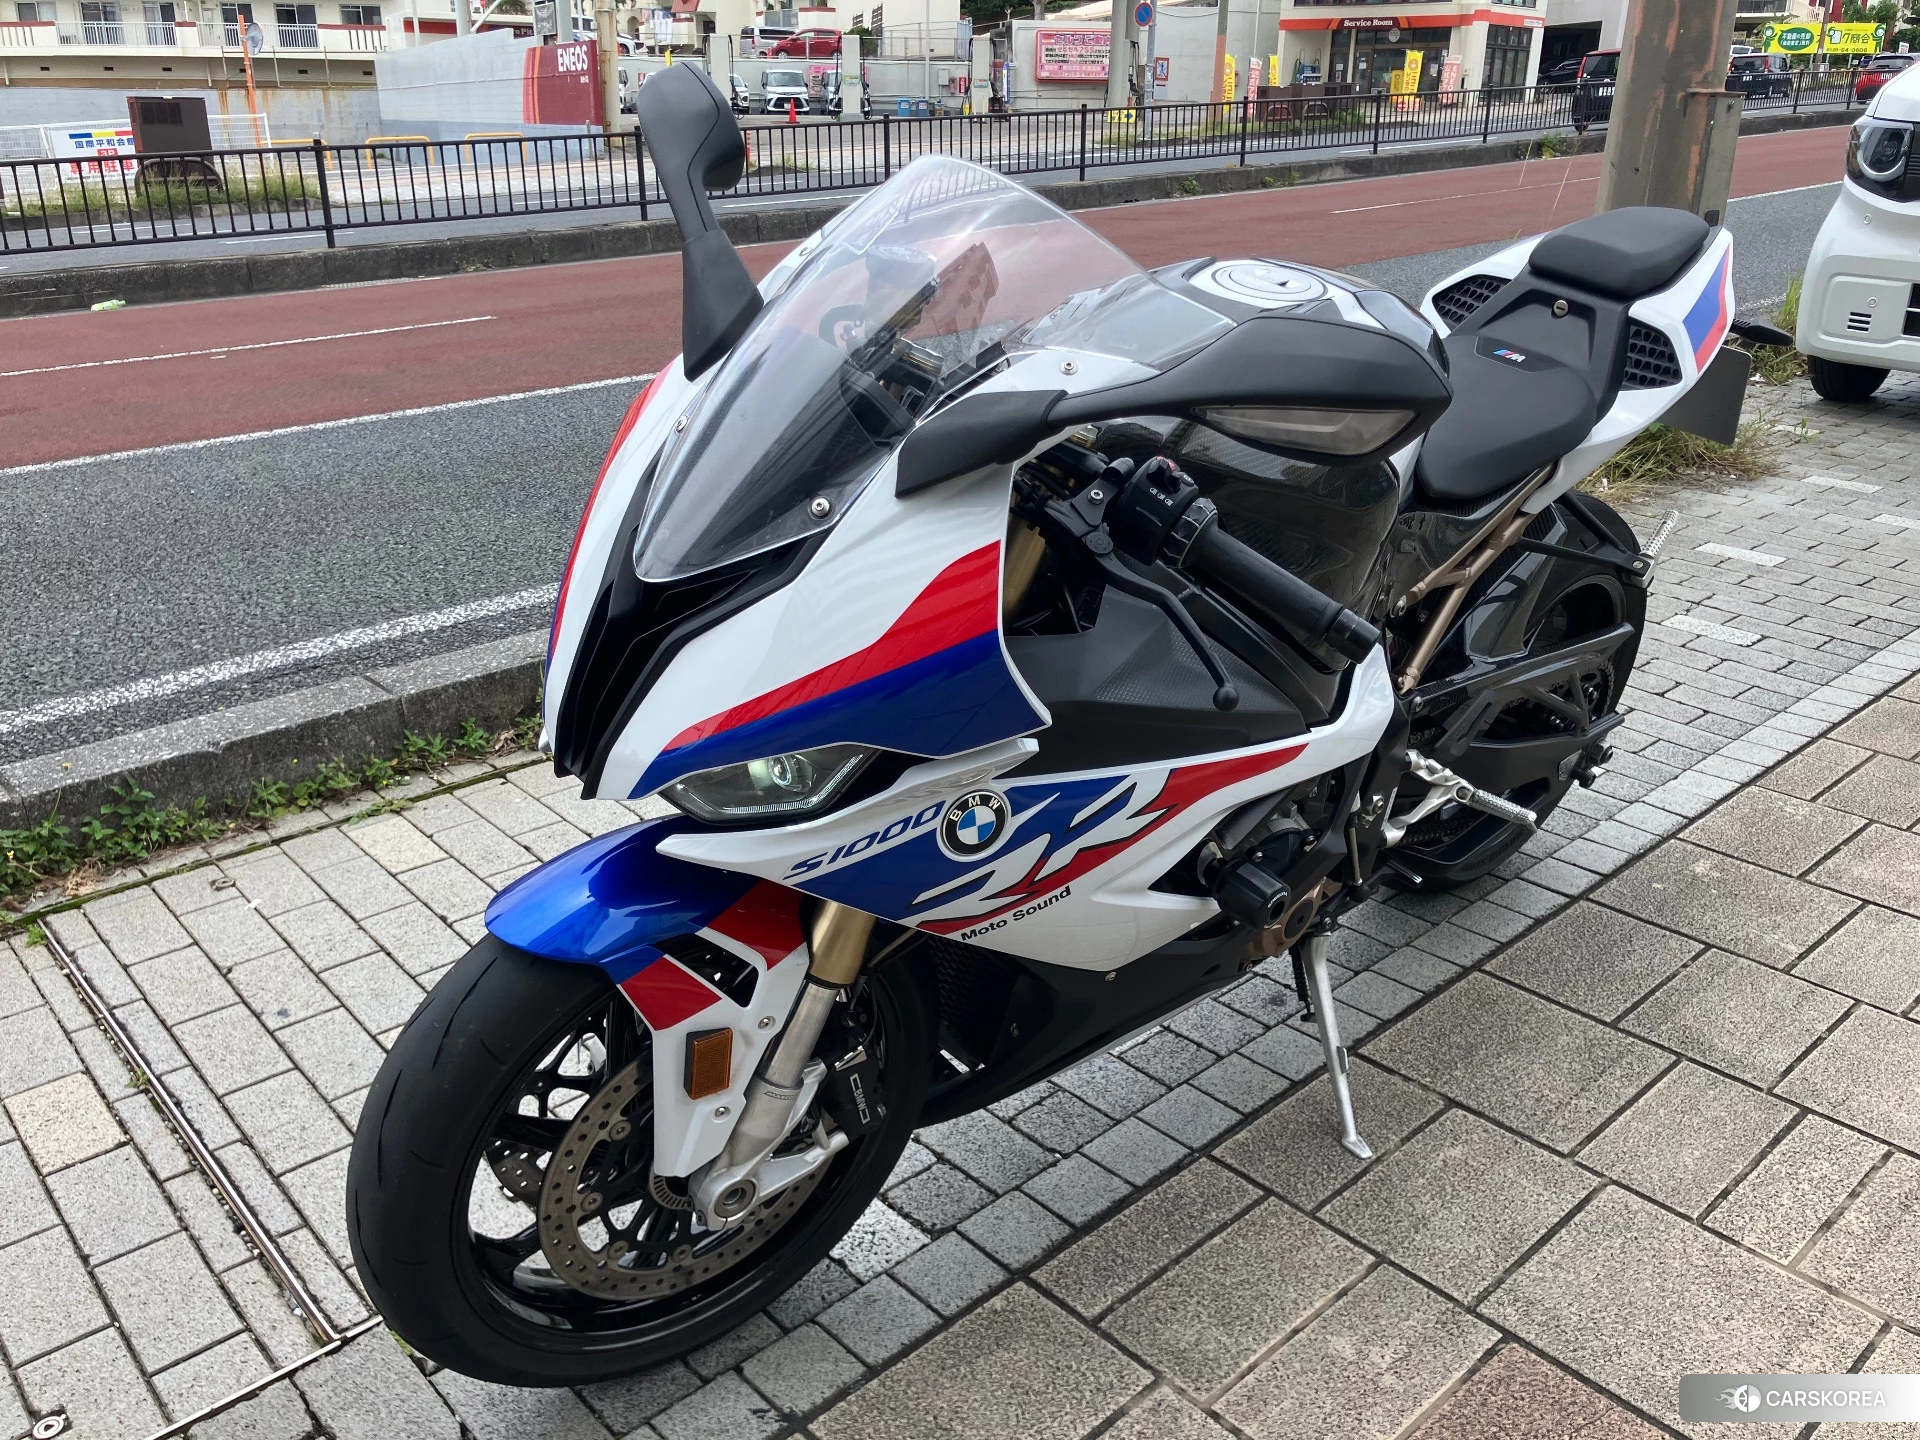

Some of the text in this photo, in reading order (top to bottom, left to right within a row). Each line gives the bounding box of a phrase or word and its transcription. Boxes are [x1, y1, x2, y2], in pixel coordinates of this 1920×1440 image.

[1343, 19, 1372, 27] Service
[557, 44, 588, 72] ENEOS
[949, 795, 1001, 821] BMW
[783, 800, 946, 880] S1000
[961, 885, 1072, 941] Moto Sound
[854, 1088, 867, 1111] BMW
